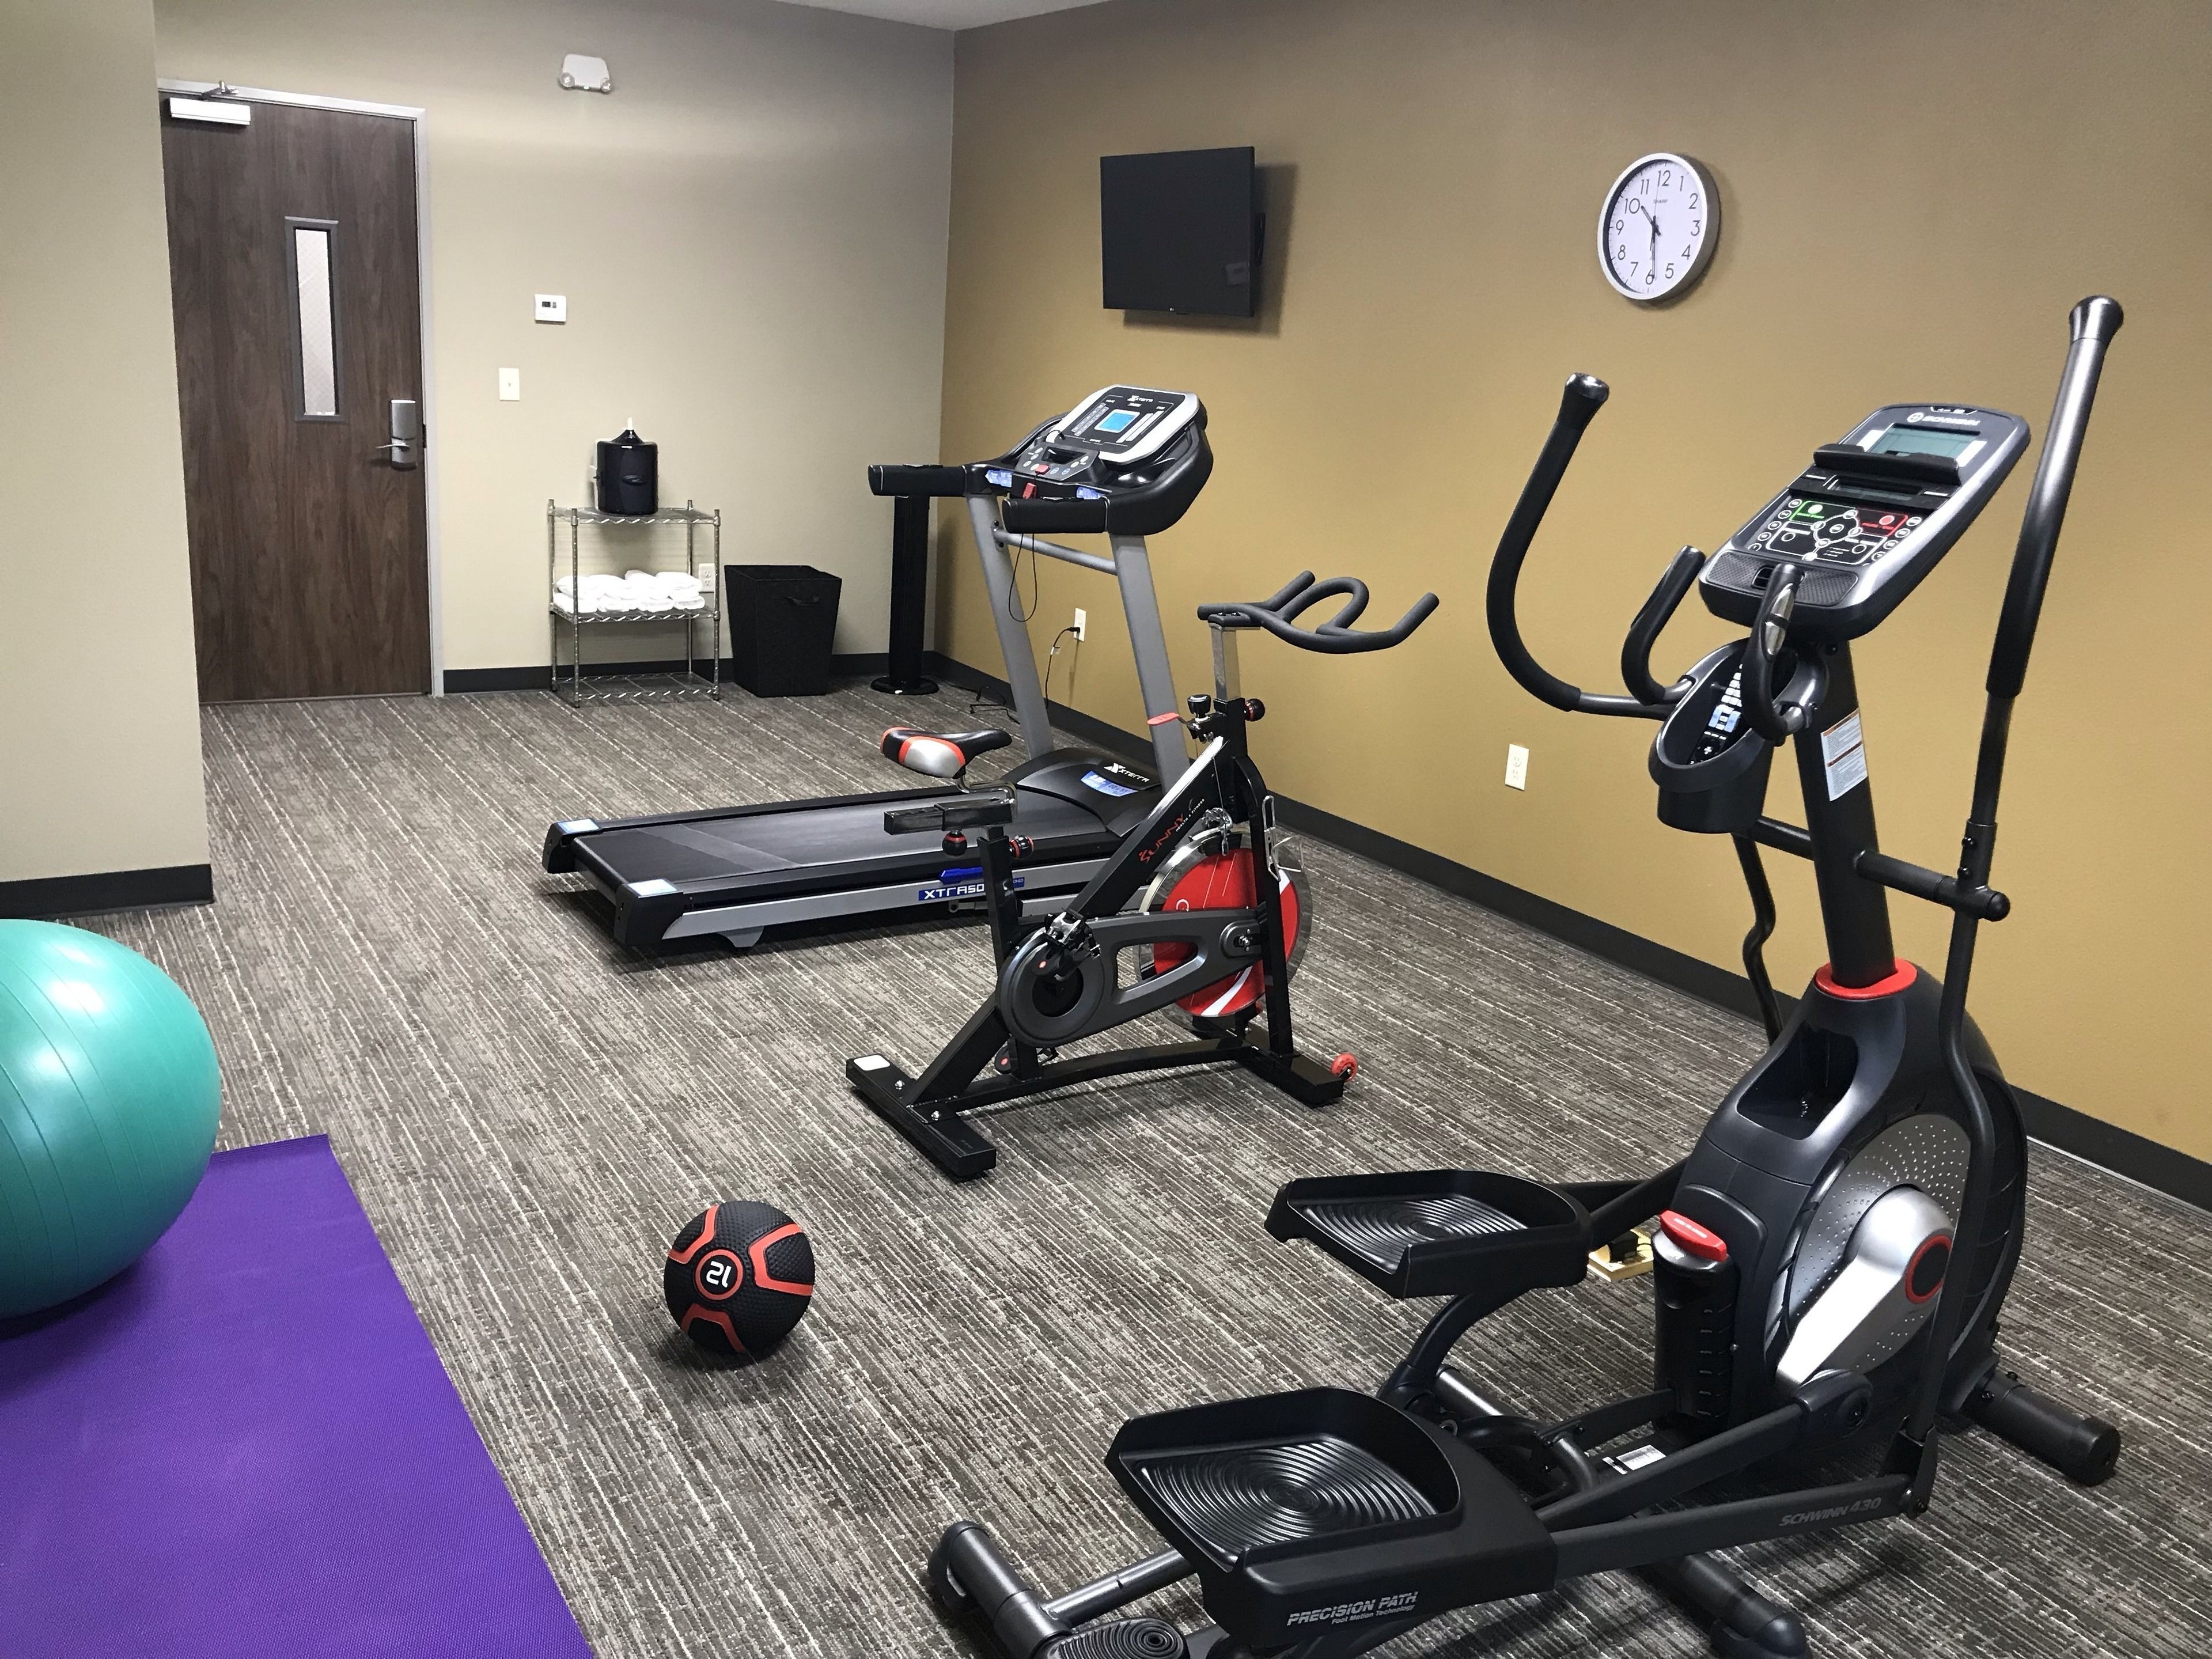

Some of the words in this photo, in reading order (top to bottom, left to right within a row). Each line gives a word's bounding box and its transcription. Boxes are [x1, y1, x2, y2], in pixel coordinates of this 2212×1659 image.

[1658, 170, 1671, 187] 12
[1680, 175, 1684, 192] 1
[1640, 179, 1650, 195] 11
[1624, 198, 1641, 214] 10
[1688, 192, 1699, 210] 2
[1616, 219, 1624, 236] 9
[1691, 220, 1701, 236] 3
[1618, 244, 1626, 260] 8
[1681, 244, 1691, 260] 4
[1630, 262, 1639, 277] 7
[1645, 269, 1655, 285] 6
[1665, 263, 1675, 279] 5
[1138, 813, 1184, 863] SUNNY
[1779, 1505, 1850, 1527] SCHWINN
[1849, 1497, 1882, 1513] 430
[1286, 1599, 1376, 1627] PRECISION
[1377, 1591, 1419, 1609] PATH
[1331, 1616, 1348, 1625] Foot
[1349, 1612, 1374, 1622] Motion
[1375, 1604, 1415, 1617] Technology
